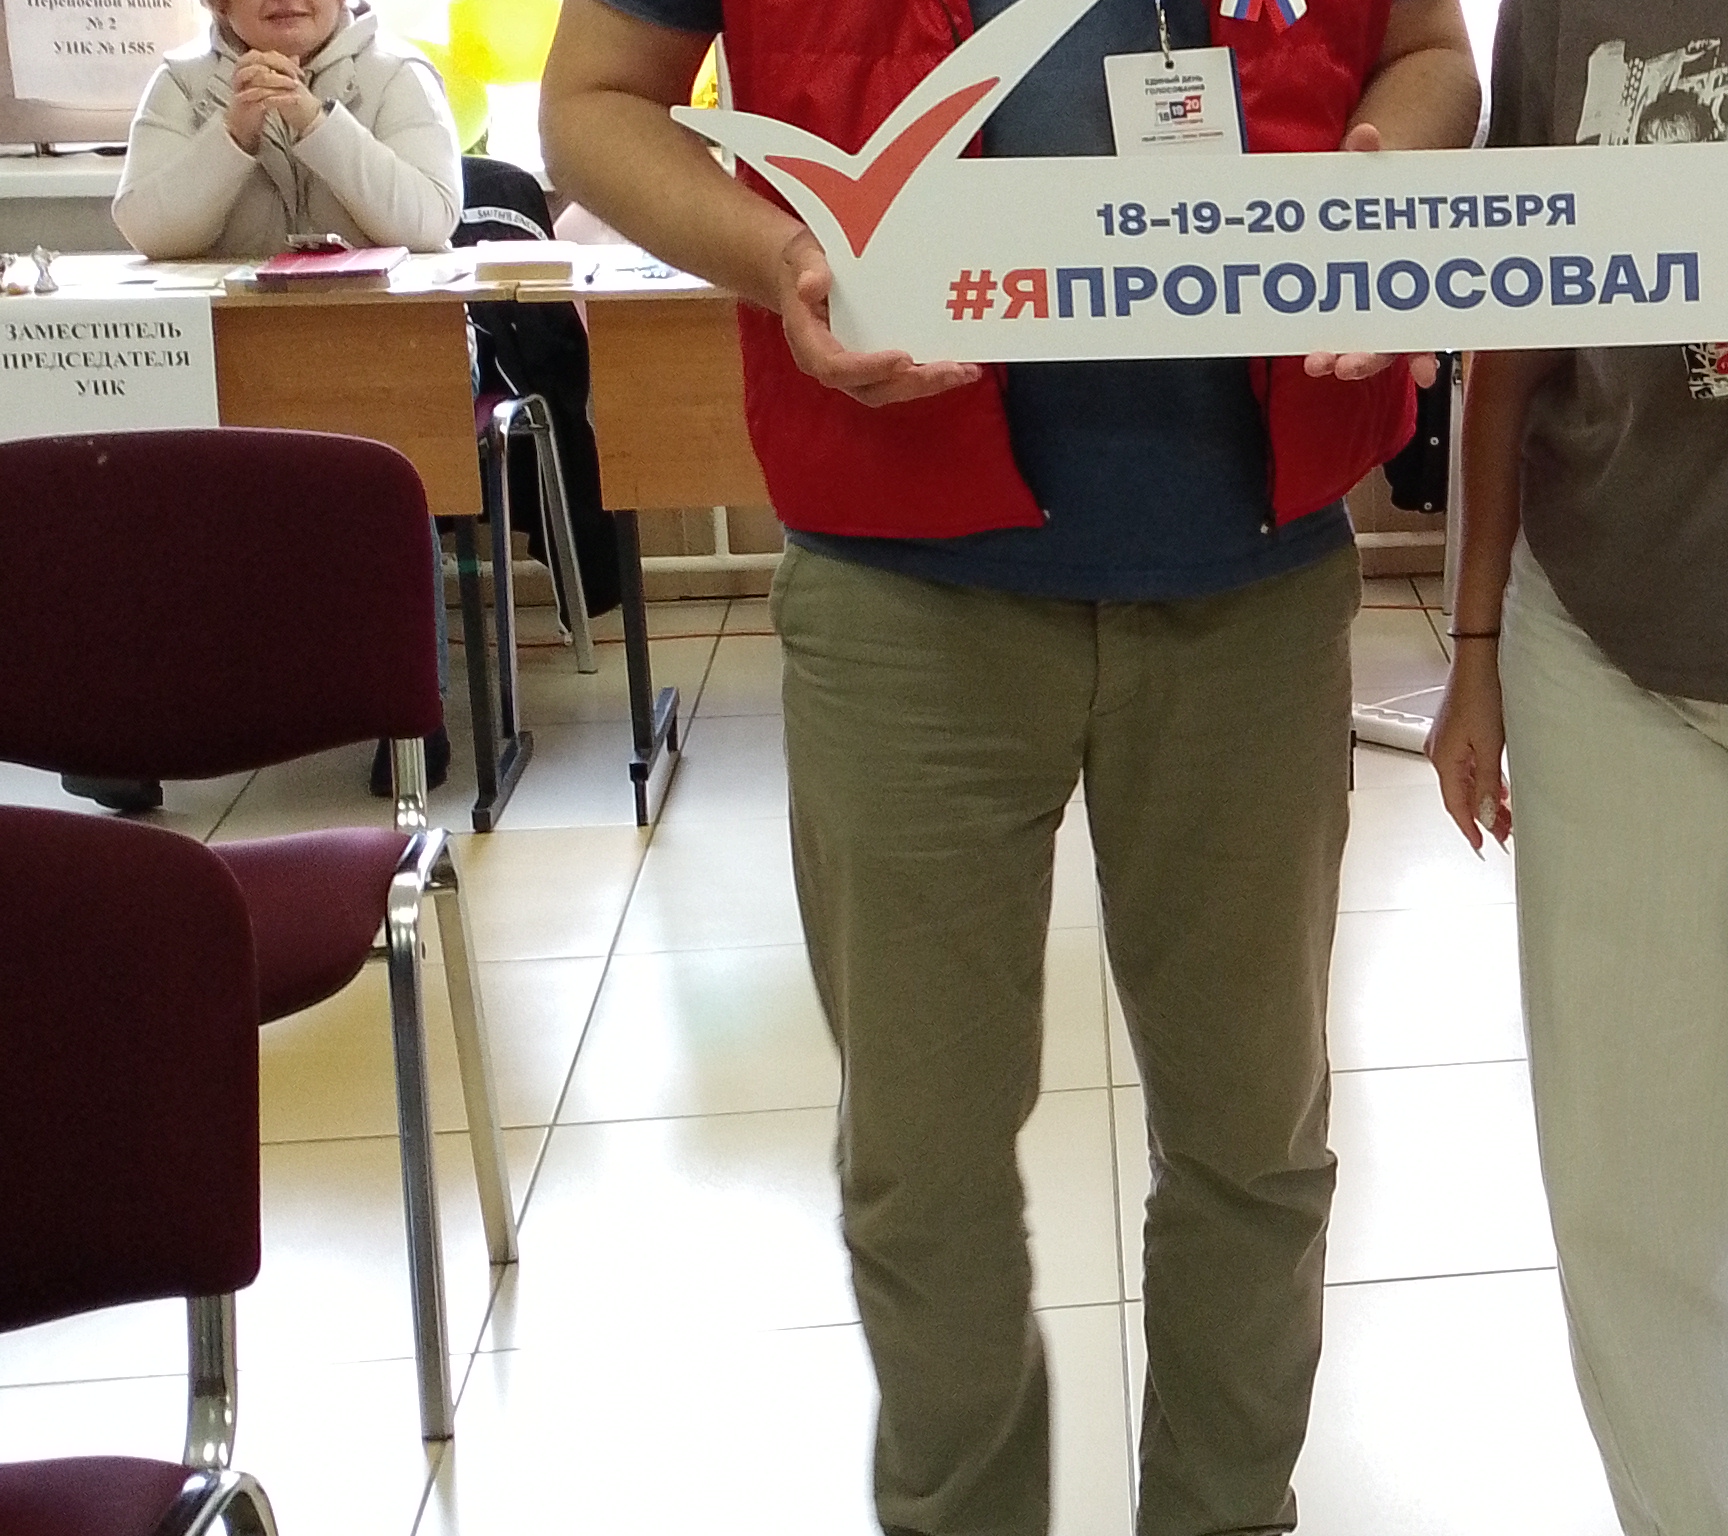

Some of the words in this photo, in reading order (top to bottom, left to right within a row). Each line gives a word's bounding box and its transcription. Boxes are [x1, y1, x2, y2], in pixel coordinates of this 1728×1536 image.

[86, 16, 104, 31] №
[108, 16, 117, 31] 2
[53, 40, 93, 55] УИК
[96, 41, 116, 55] №
[120, 41, 155, 55] 1585
[1171, 105, 1184, 117] 19
[1184, 98, 1200, 110] 20
[1318, 192, 1577, 232] СЕНТЯБРЯ
[944, 251, 1701, 321] #ЯПРОГОЛОСОВАЛ
[5, 321, 182, 341] ЗАМЕСТИТЕЛЬ
[1, 350, 190, 371] ПРЕДСЕДАТЕЛЯ
[75, 379, 126, 396] УИК
